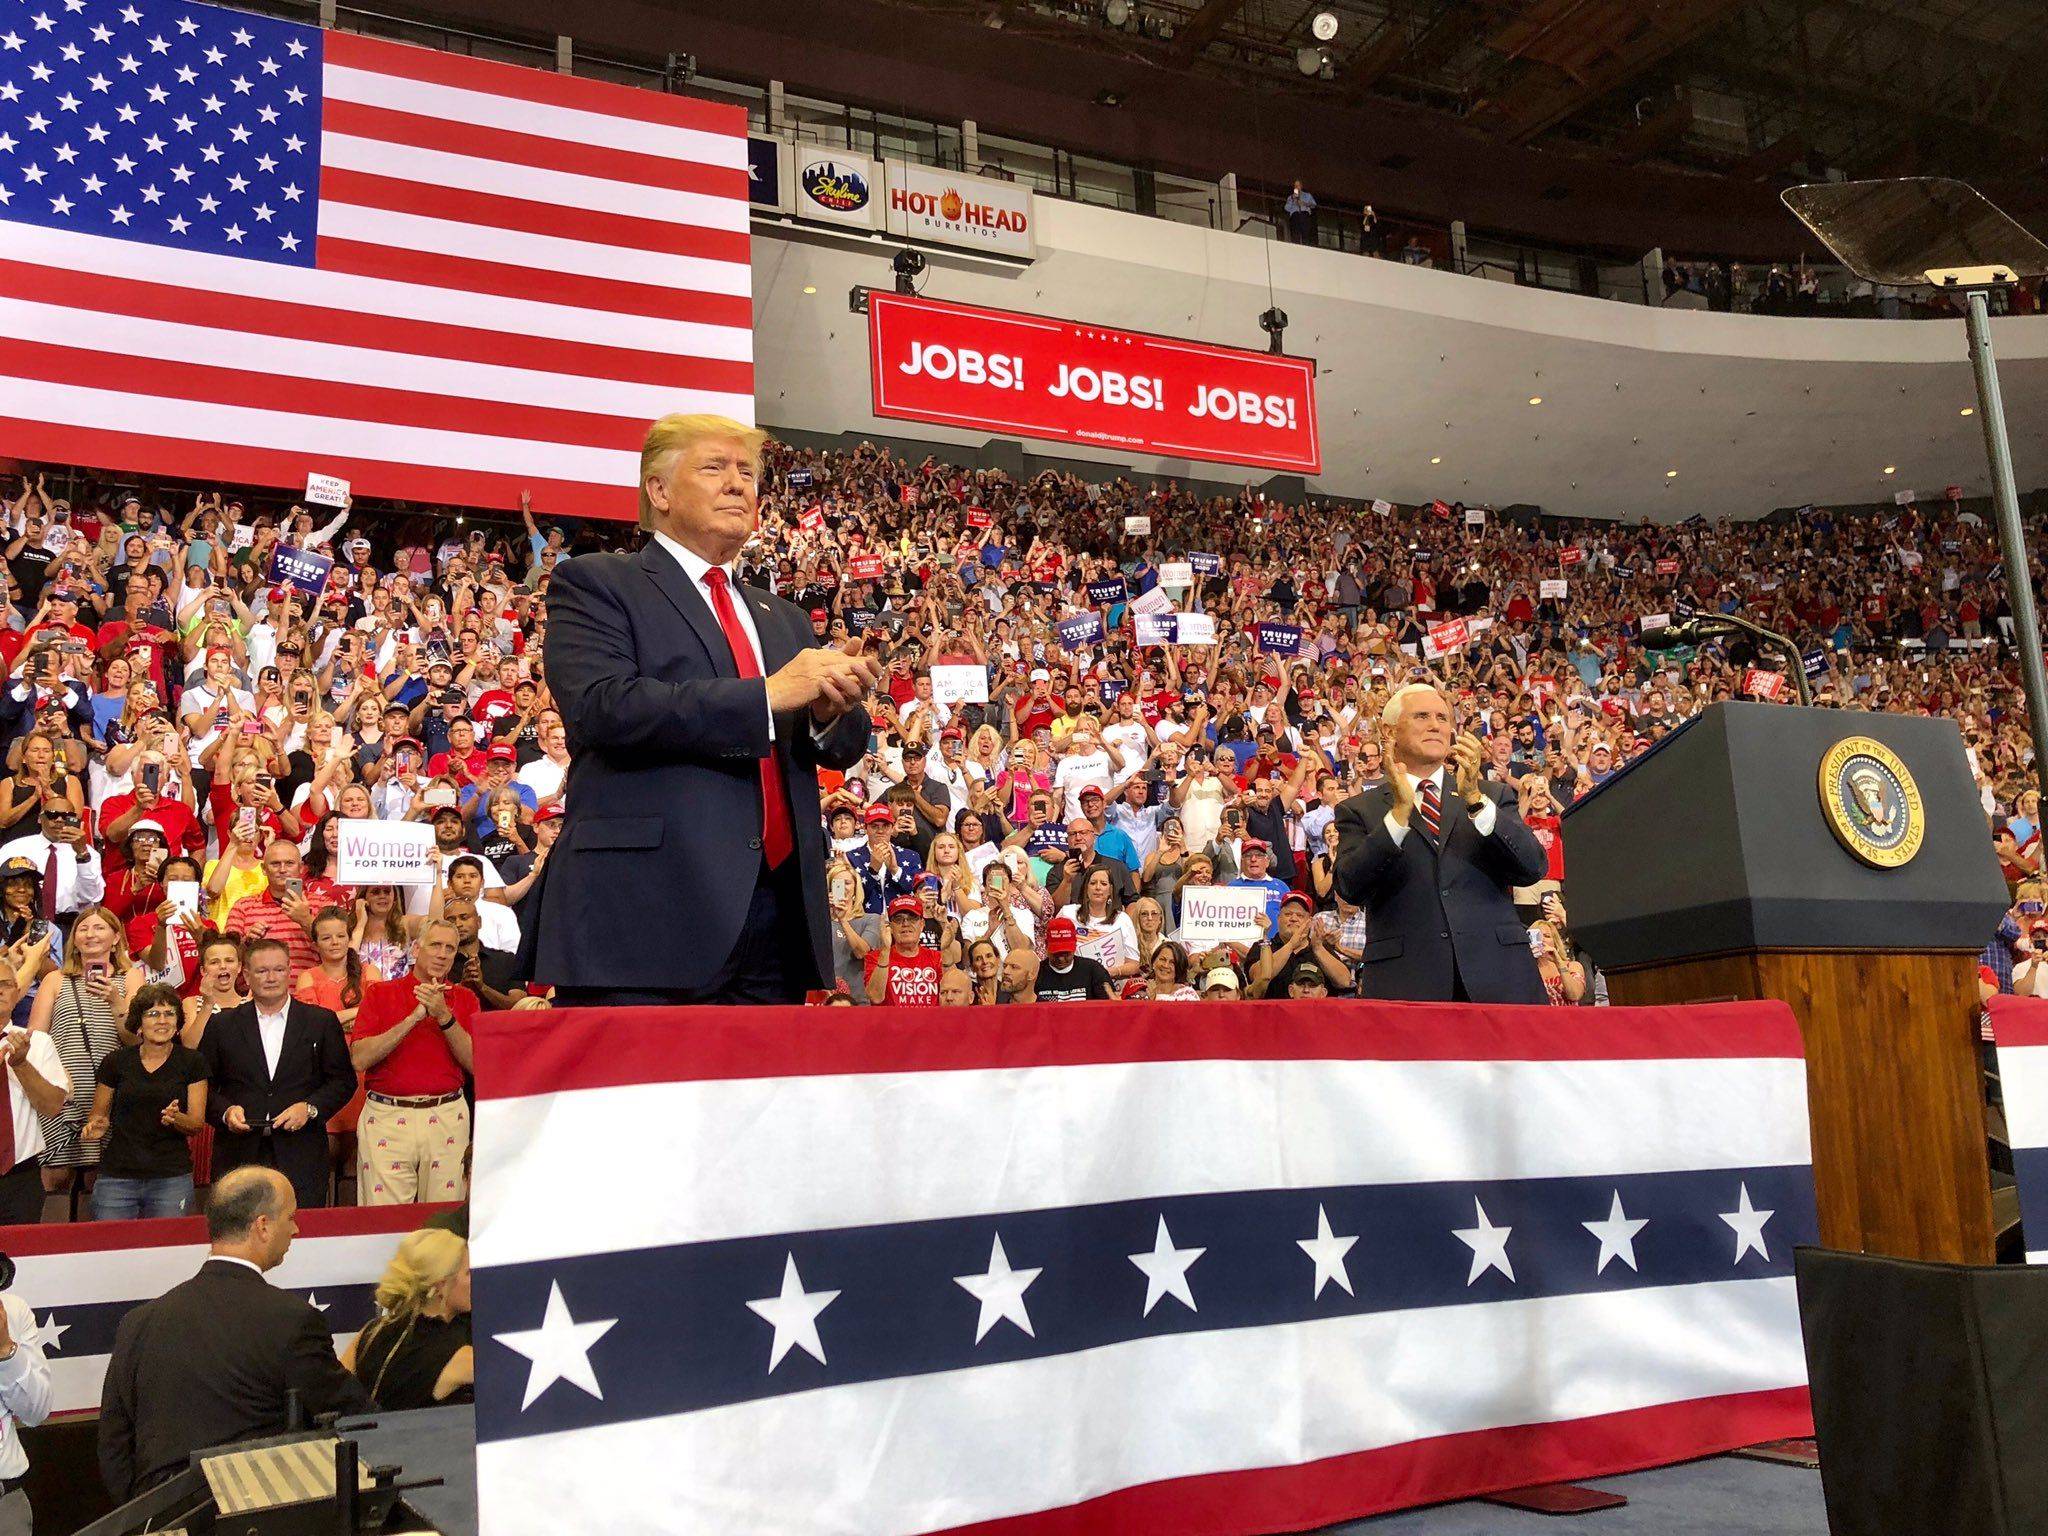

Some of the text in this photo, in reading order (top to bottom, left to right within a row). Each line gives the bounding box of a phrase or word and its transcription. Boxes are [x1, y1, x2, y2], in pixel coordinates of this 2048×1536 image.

[813, 177, 862, 203] Skyline
[891, 187, 1028, 233] HOT HEAD
[924, 218, 998, 238] BURRITOS
[899, 341, 1297, 429] JOBS! JOBS! JOBS!
[1075, 429, 1145, 445] donaldjtrump.com
[310, 484, 348, 497] AMERICA
[276, 554, 325, 575] TRUMP
[851, 559, 881, 567] TRUMP
[1189, 556, 1218, 565] TRUMP
[1089, 585, 1123, 594] TRUMP
[1062, 620, 1100, 635] TRUMP
[1261, 630, 1299, 640] TRUMP
[1804, 655, 1824, 666] UMP
[1873, 747, 1886, 759] THE
[1828, 742, 1859, 796] PRESIDENT
[1889, 760, 1918, 811] UNITED
[1034, 829, 1068, 838] RUM
[1852, 836, 1878, 860] SEAL
[1894, 823, 1920, 861] STATES
[355, 860, 421, 868] FOR TRUMP
[1188, 900, 1259, 919] Women
[1195, 920, 1214, 928] FOR
[890, 966, 937, 983] 2020
[891, 982, 938, 996] VISION
[899, 995, 932, 1004] MAKE
